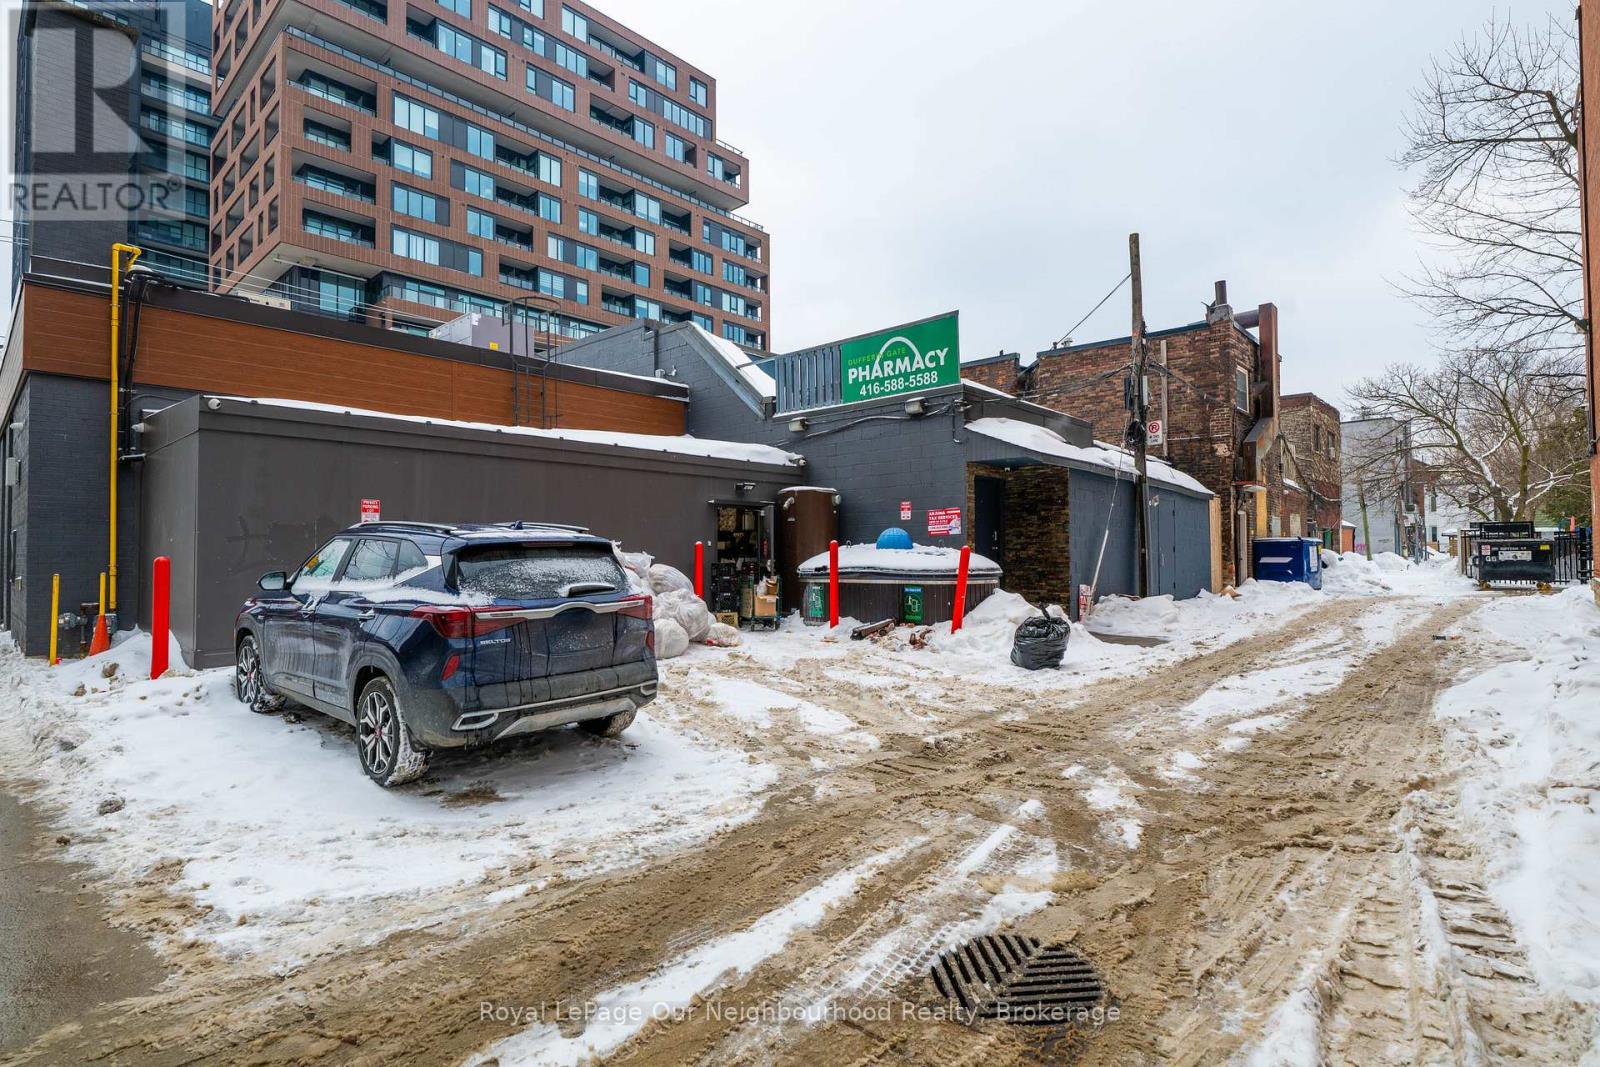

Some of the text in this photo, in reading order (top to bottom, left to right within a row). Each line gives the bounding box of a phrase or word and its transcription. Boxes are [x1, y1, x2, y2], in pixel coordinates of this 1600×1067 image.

[886, 347, 907, 357] GATE
[848, 348, 949, 384] PHARMACY
[860, 371, 938, 396] 416-588-5588
